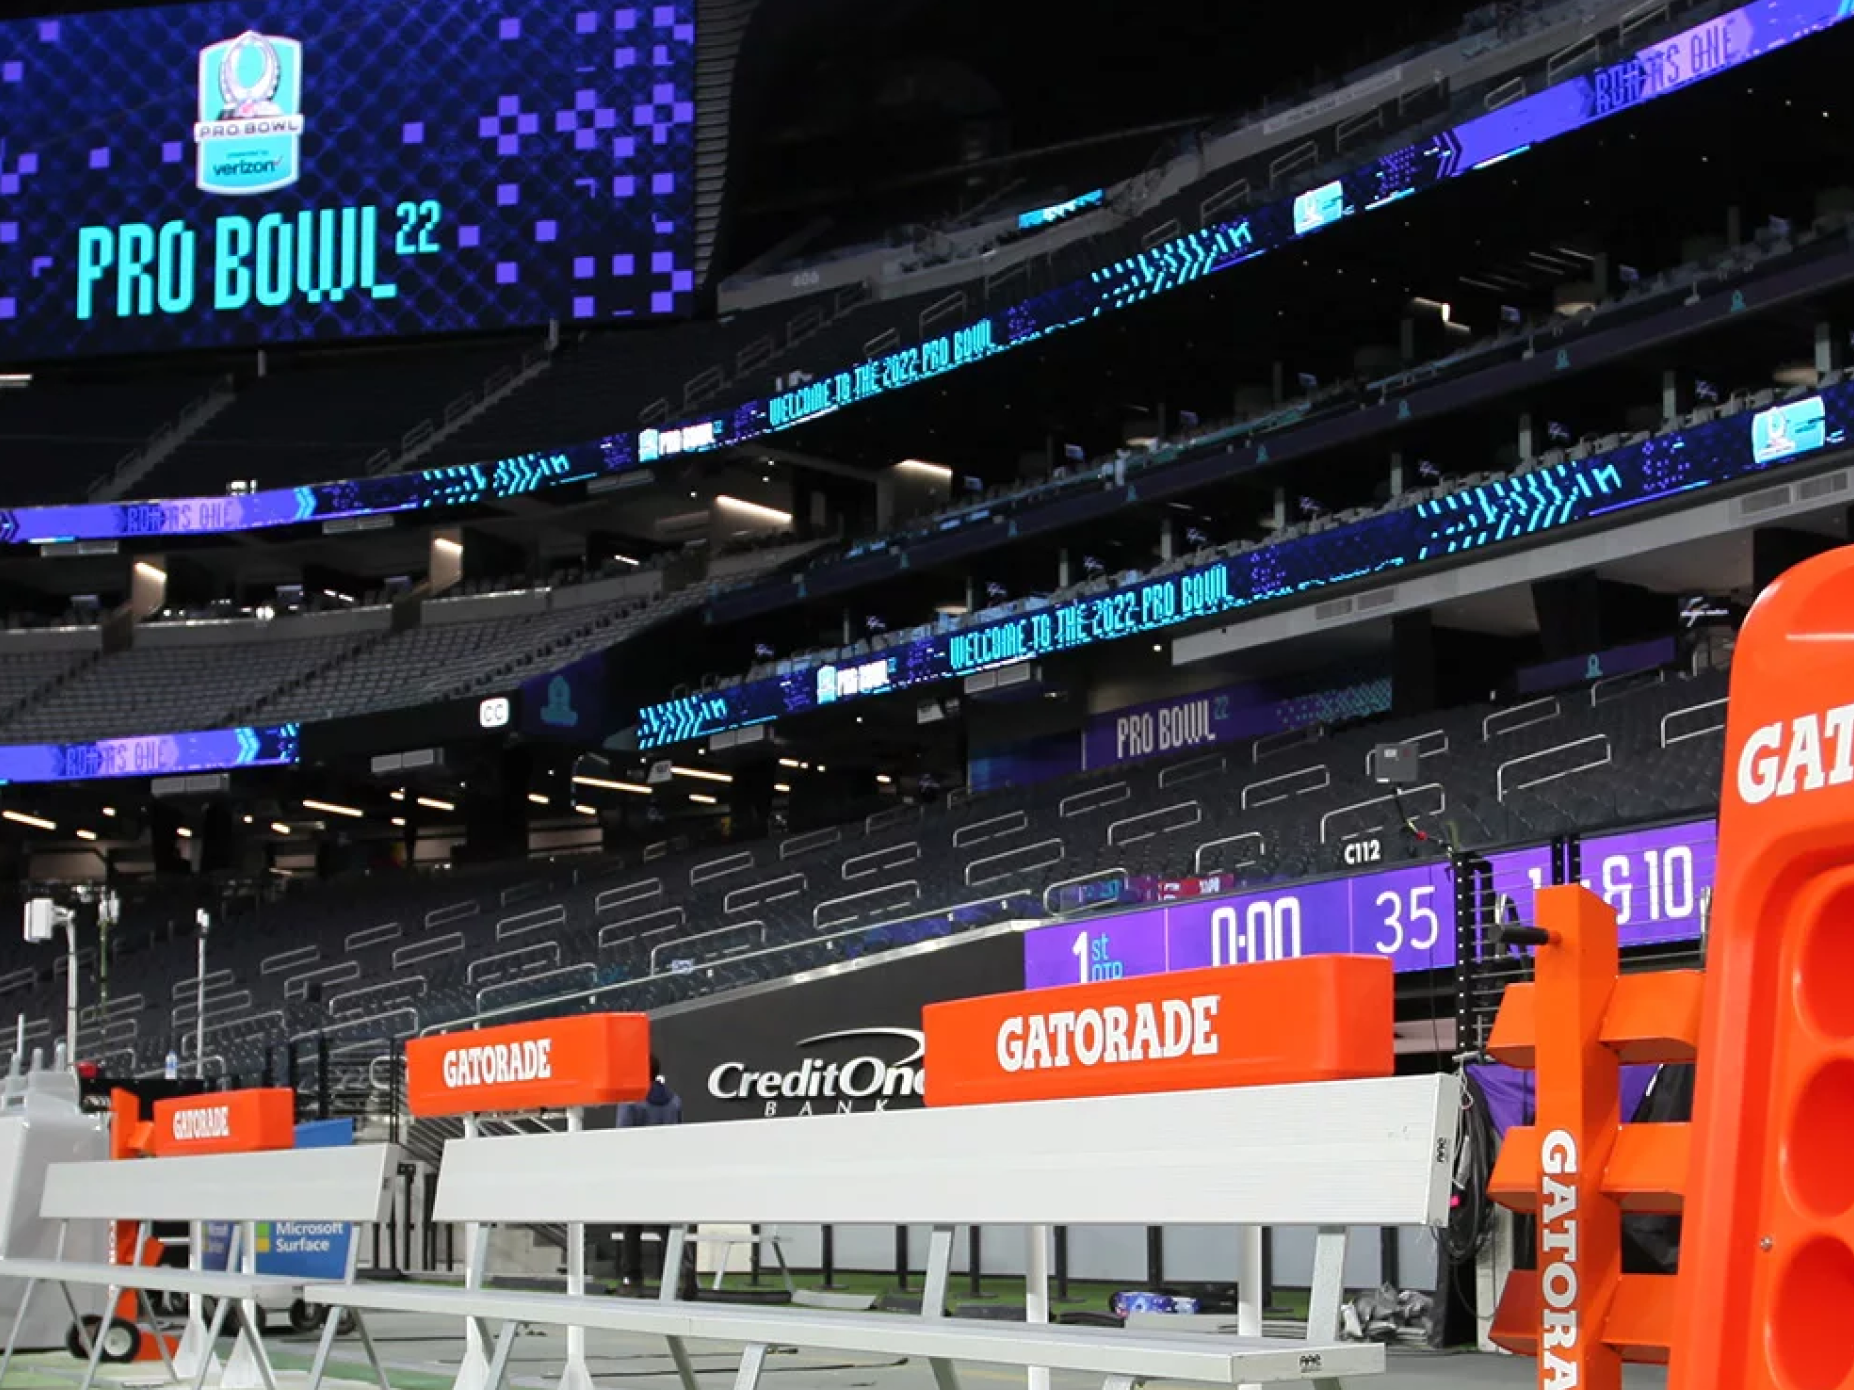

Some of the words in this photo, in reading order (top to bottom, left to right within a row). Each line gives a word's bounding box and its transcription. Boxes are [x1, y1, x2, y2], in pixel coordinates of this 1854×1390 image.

[199, 125, 239, 138] PRO
[244, 121, 299, 134] BOWL
[213, 160, 276, 176] verizon
[76, 219, 195, 320] PRO
[213, 205, 397, 310] BOWL
[395, 200, 441, 255] 22
[769, 378, 832, 427] WELCOME
[834, 372, 852, 402] TO
[853, 360, 881, 400] THE
[922, 336, 949, 373] PRO
[954, 318, 994, 362] BOWL
[950, 618, 1028, 670] WELCOME
[1031, 612, 1051, 651] TO
[1055, 601, 1091, 646] THE
[1092, 590, 1138, 636] 2022
[1142, 581, 1175, 623] PRO
[1181, 561, 1232, 613] BOWL
[1117, 711, 1153, 759] PRO
[1158, 698, 1216, 751] BOWL
[1344, 840, 1381, 865] C112
[1643, 845, 1693, 921] 10
[1375, 886, 1439, 954] 35
[996, 995, 1221, 1072] GATORADE
[442, 1038, 551, 1088] GATORADE
[172, 1105, 229, 1141] GATORADE
[763, 1100, 889, 1118] BANK
[275, 1220, 344, 1235] Microsoft
[275, 1236, 331, 1252] Surface
